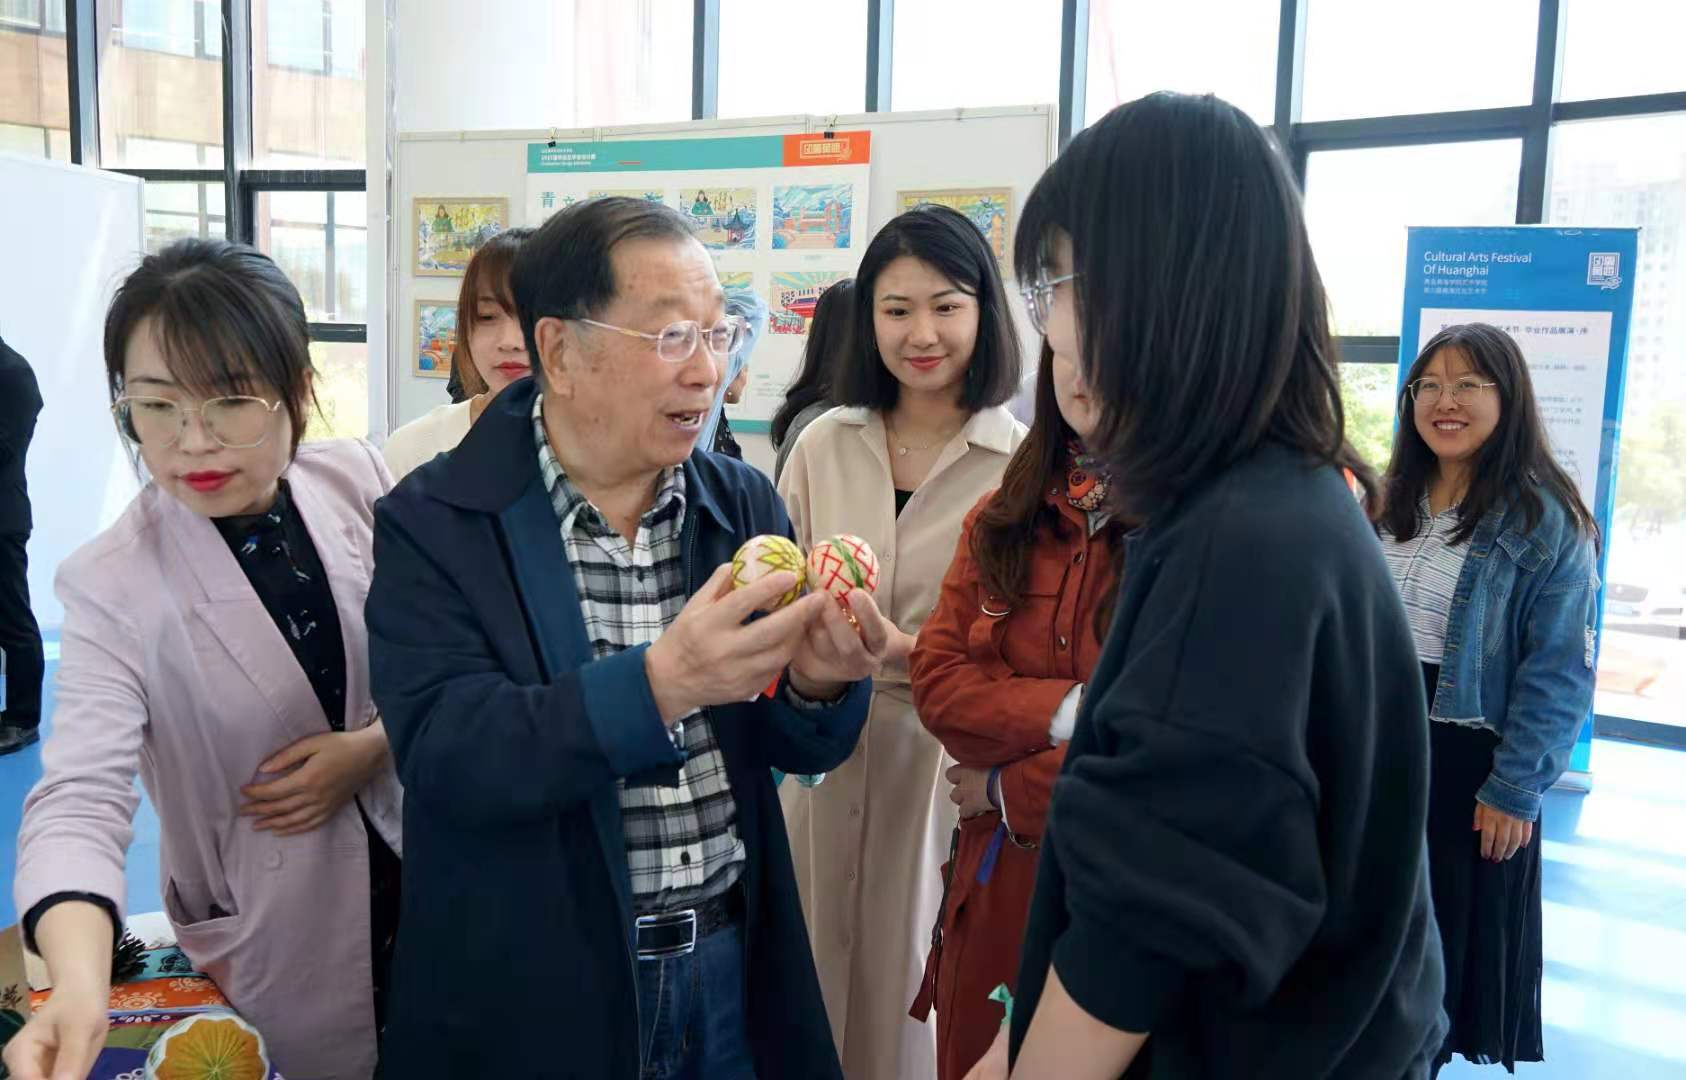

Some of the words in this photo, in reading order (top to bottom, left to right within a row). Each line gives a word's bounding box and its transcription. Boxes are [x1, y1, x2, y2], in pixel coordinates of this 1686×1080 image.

[1424, 251, 1466, 263] Cultural
[1468, 251, 1489, 263] Arts
[1491, 252, 1533, 264] Festival
[1424, 264, 1438, 275] Of
[1439, 264, 1489, 278] Huanghai
